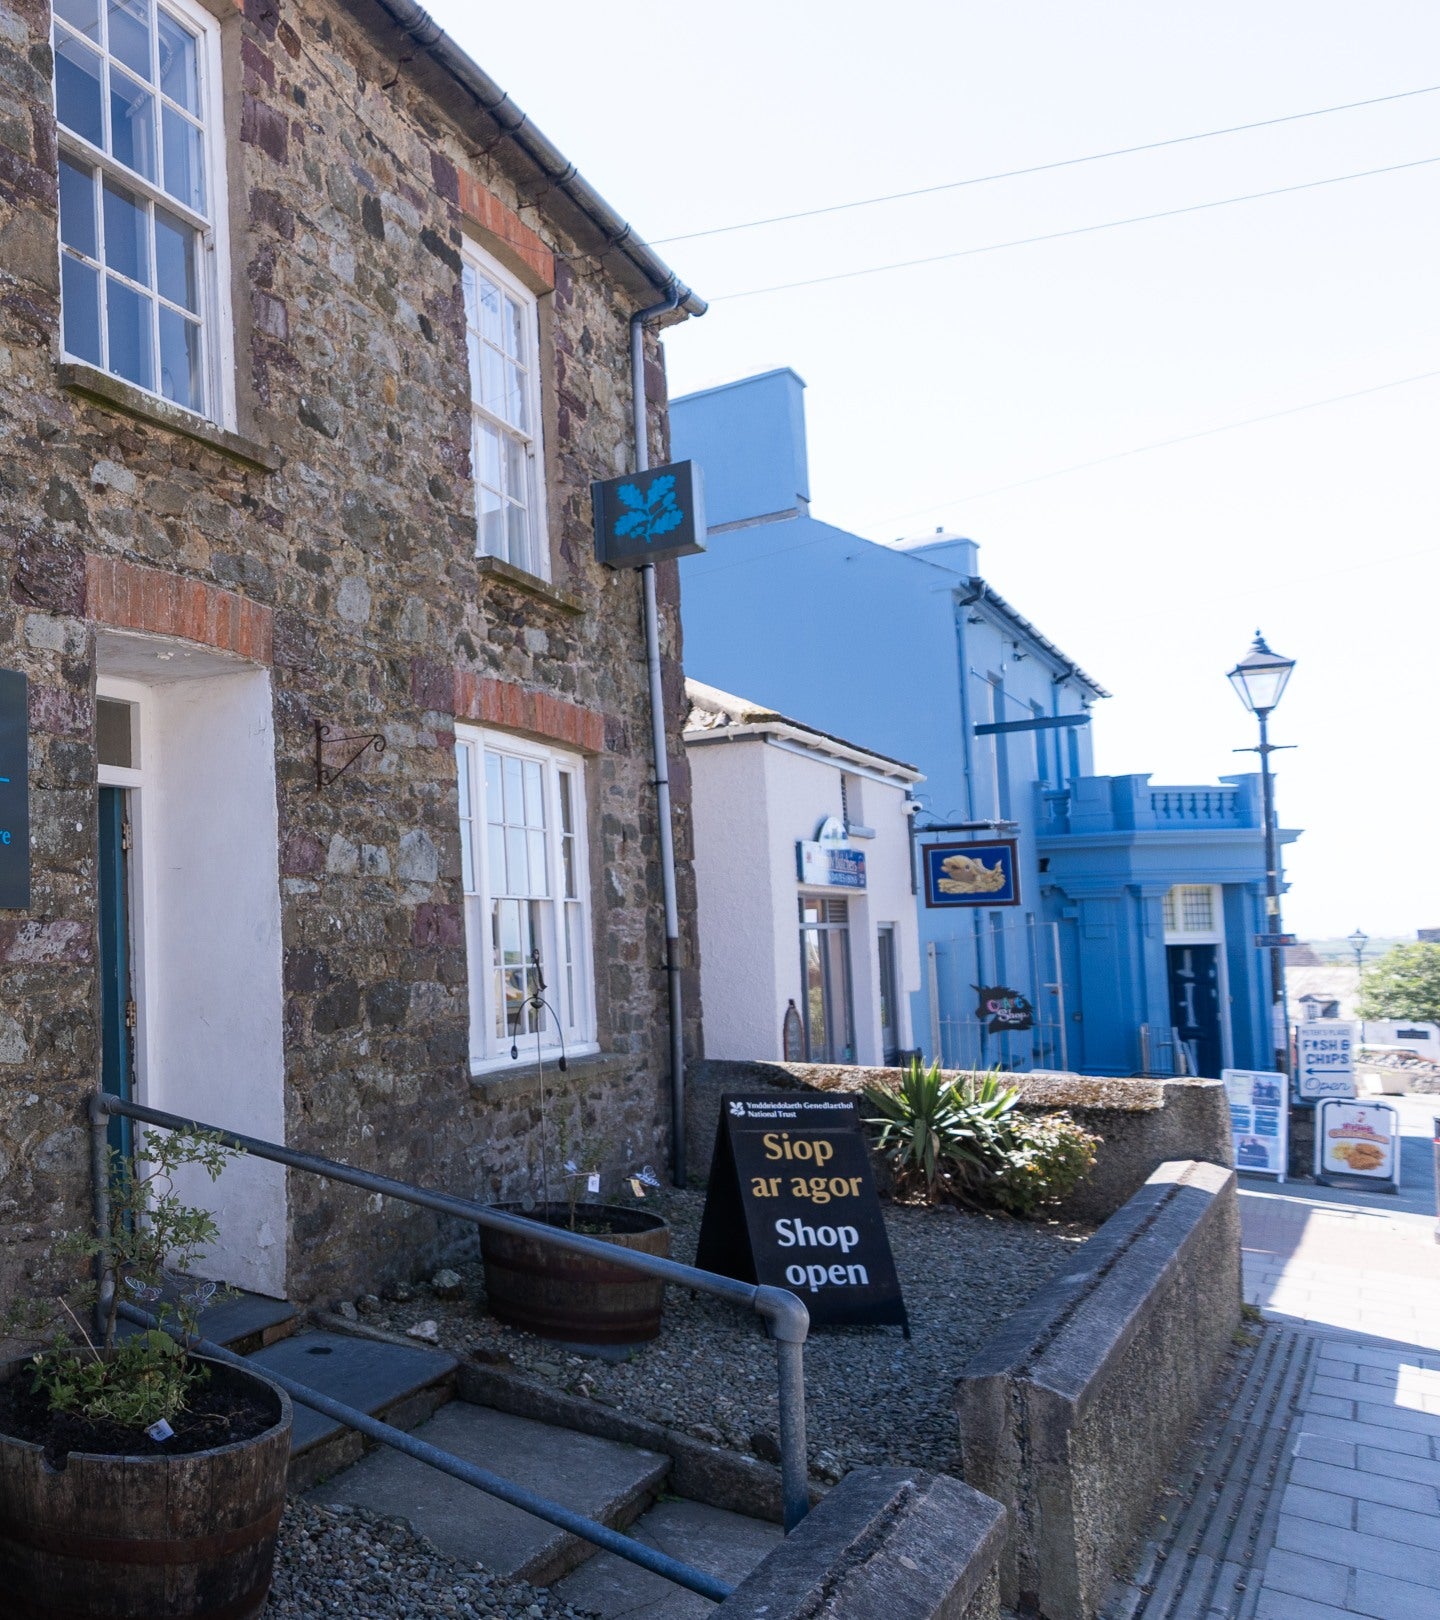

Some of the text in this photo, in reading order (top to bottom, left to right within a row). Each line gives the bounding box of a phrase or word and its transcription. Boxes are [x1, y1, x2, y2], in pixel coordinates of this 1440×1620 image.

[1303, 1040, 1338, 1050] FISH
[1306, 1054, 1350, 1064] CHIPS
[1305, 1078, 1350, 1094] Open
[763, 1133, 834, 1166] Siop
[751, 1176, 862, 1204] ar agor
[775, 1218, 859, 1253] Shop
[785, 1264, 869, 1293] open
